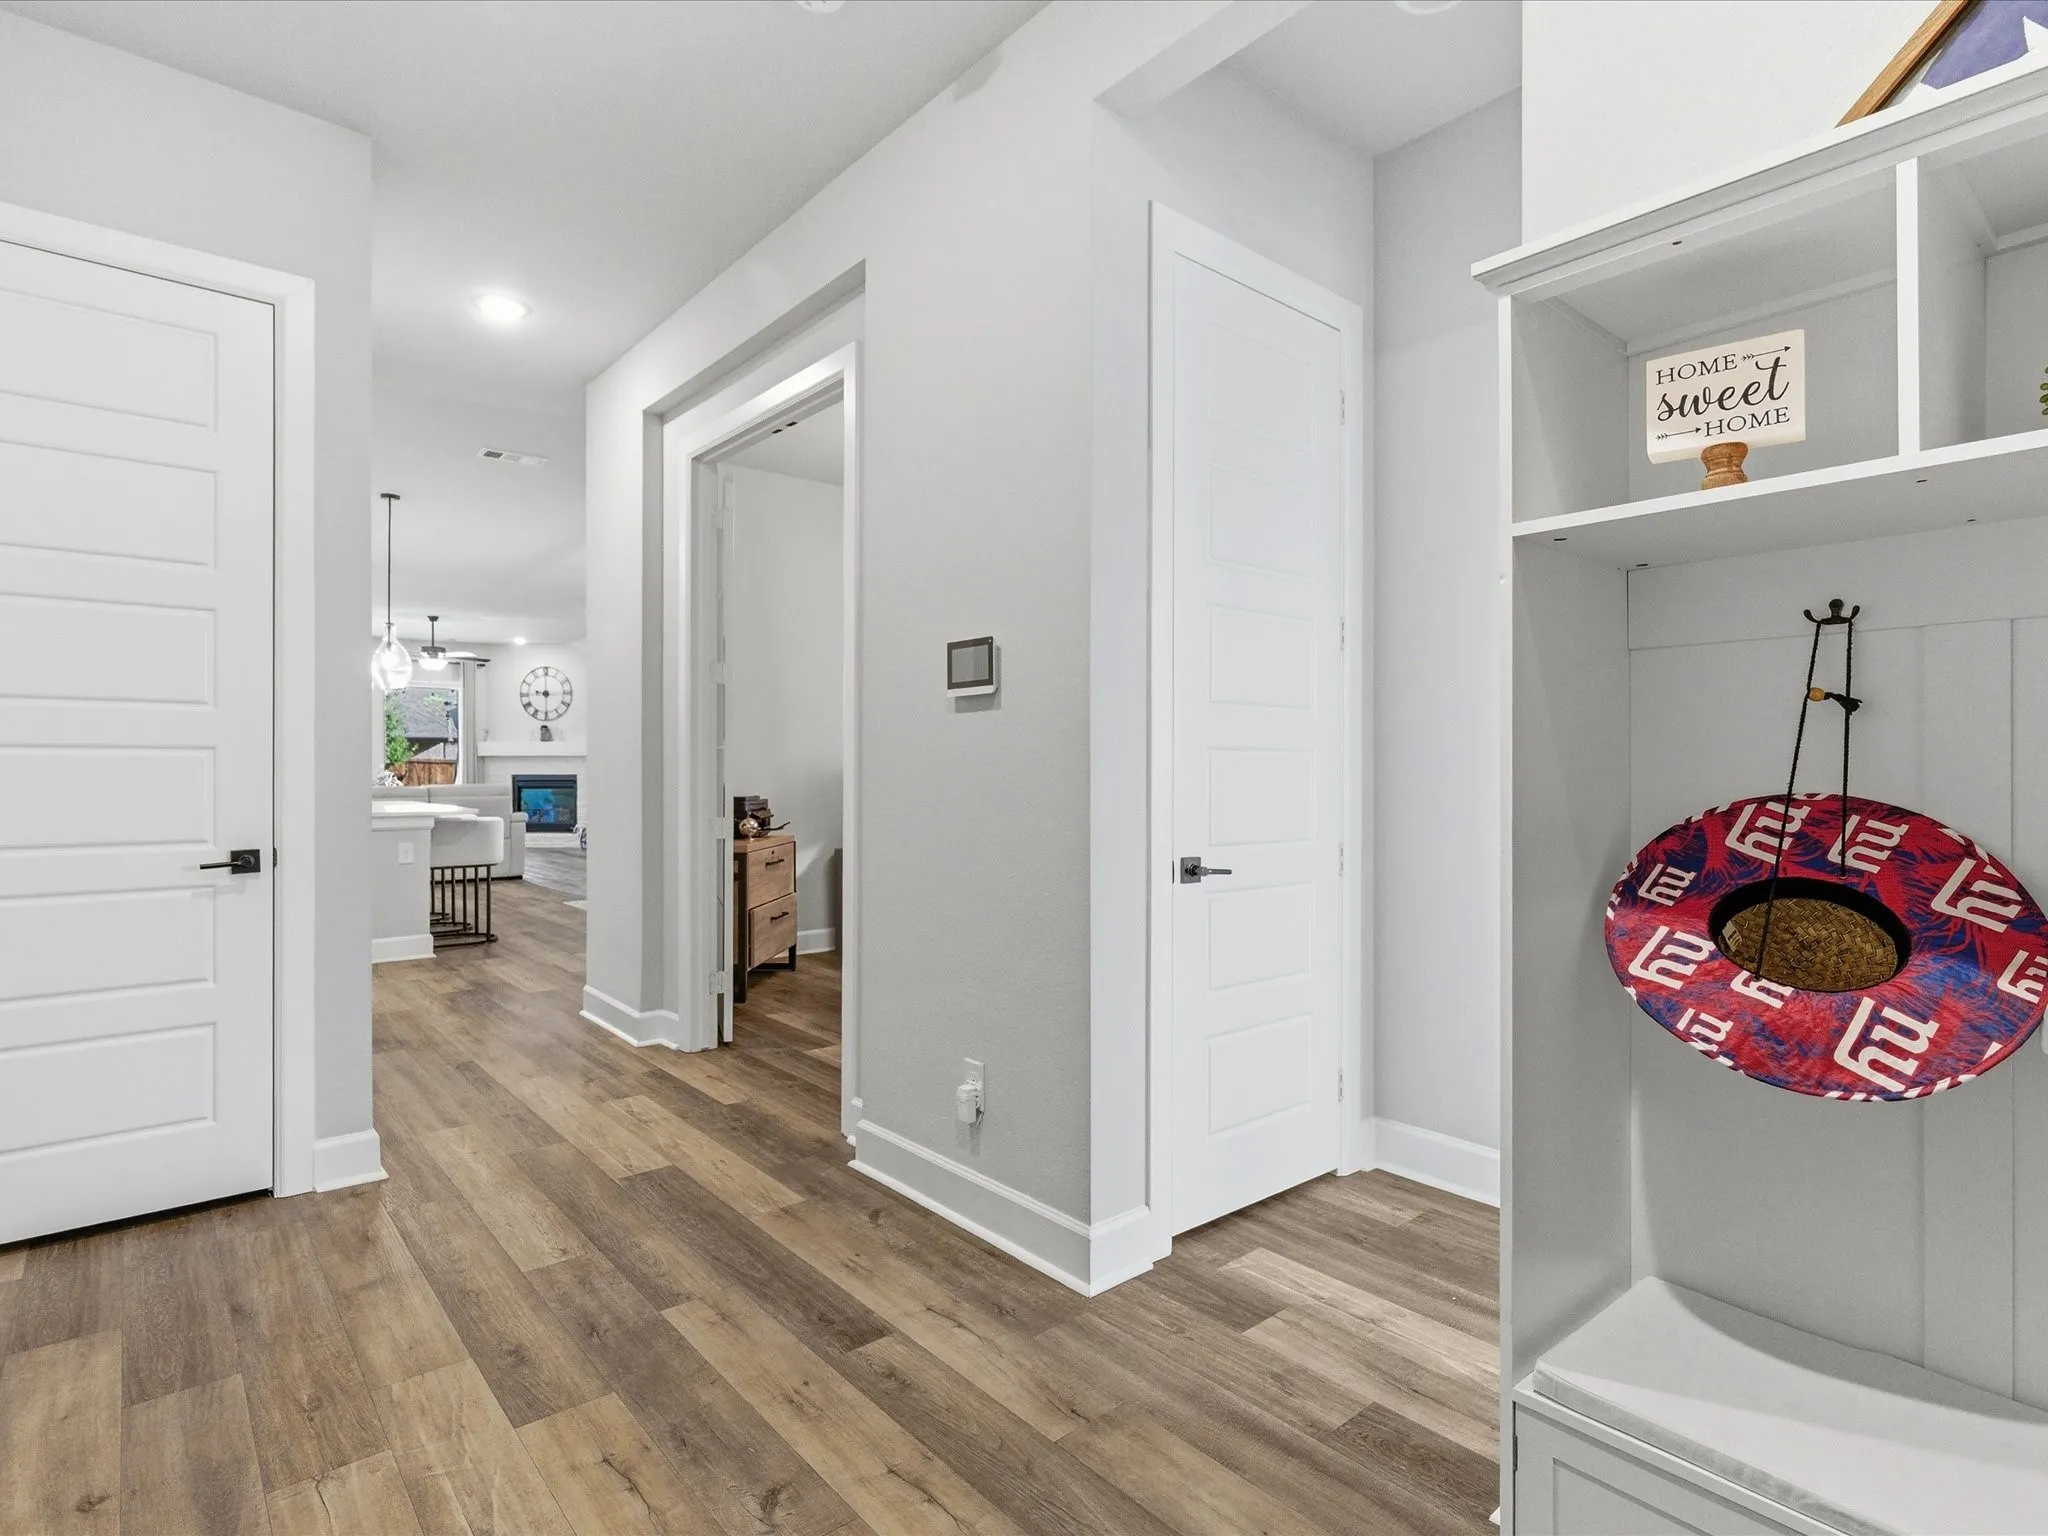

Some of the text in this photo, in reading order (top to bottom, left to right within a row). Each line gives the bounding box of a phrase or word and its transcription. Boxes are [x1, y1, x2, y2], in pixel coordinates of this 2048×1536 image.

[1656, 354, 1738, 385] HOME
[1656, 356, 1790, 422] sweet
[1704, 406, 1790, 438] HOME
